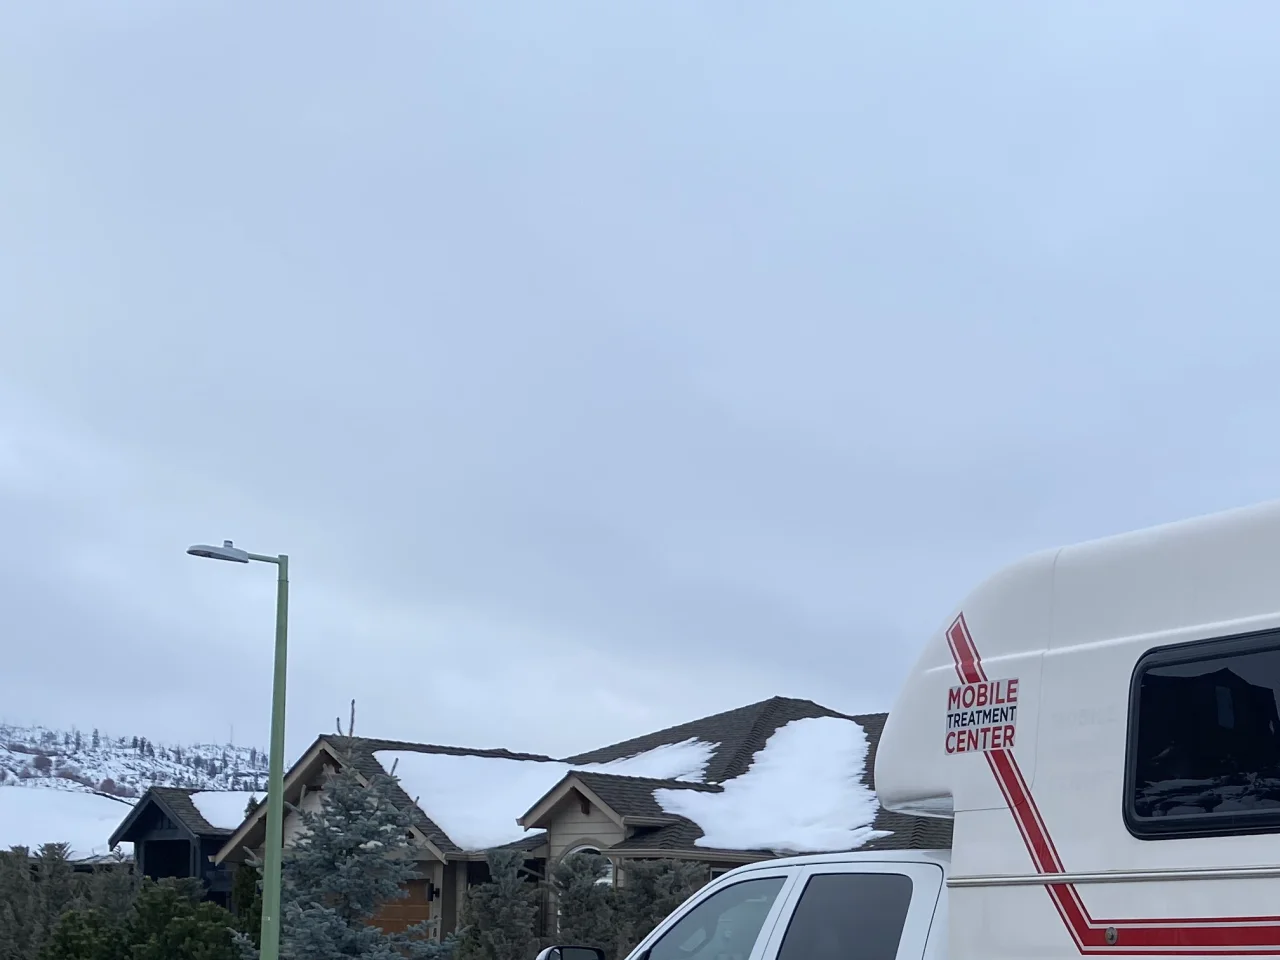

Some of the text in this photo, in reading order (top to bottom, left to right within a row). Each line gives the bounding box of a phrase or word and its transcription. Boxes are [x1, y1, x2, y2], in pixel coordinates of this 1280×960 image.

[947, 679, 1019, 711] MOBILE
[947, 706, 1017, 729] TREATMENT
[945, 724, 1015, 754] CENTER
